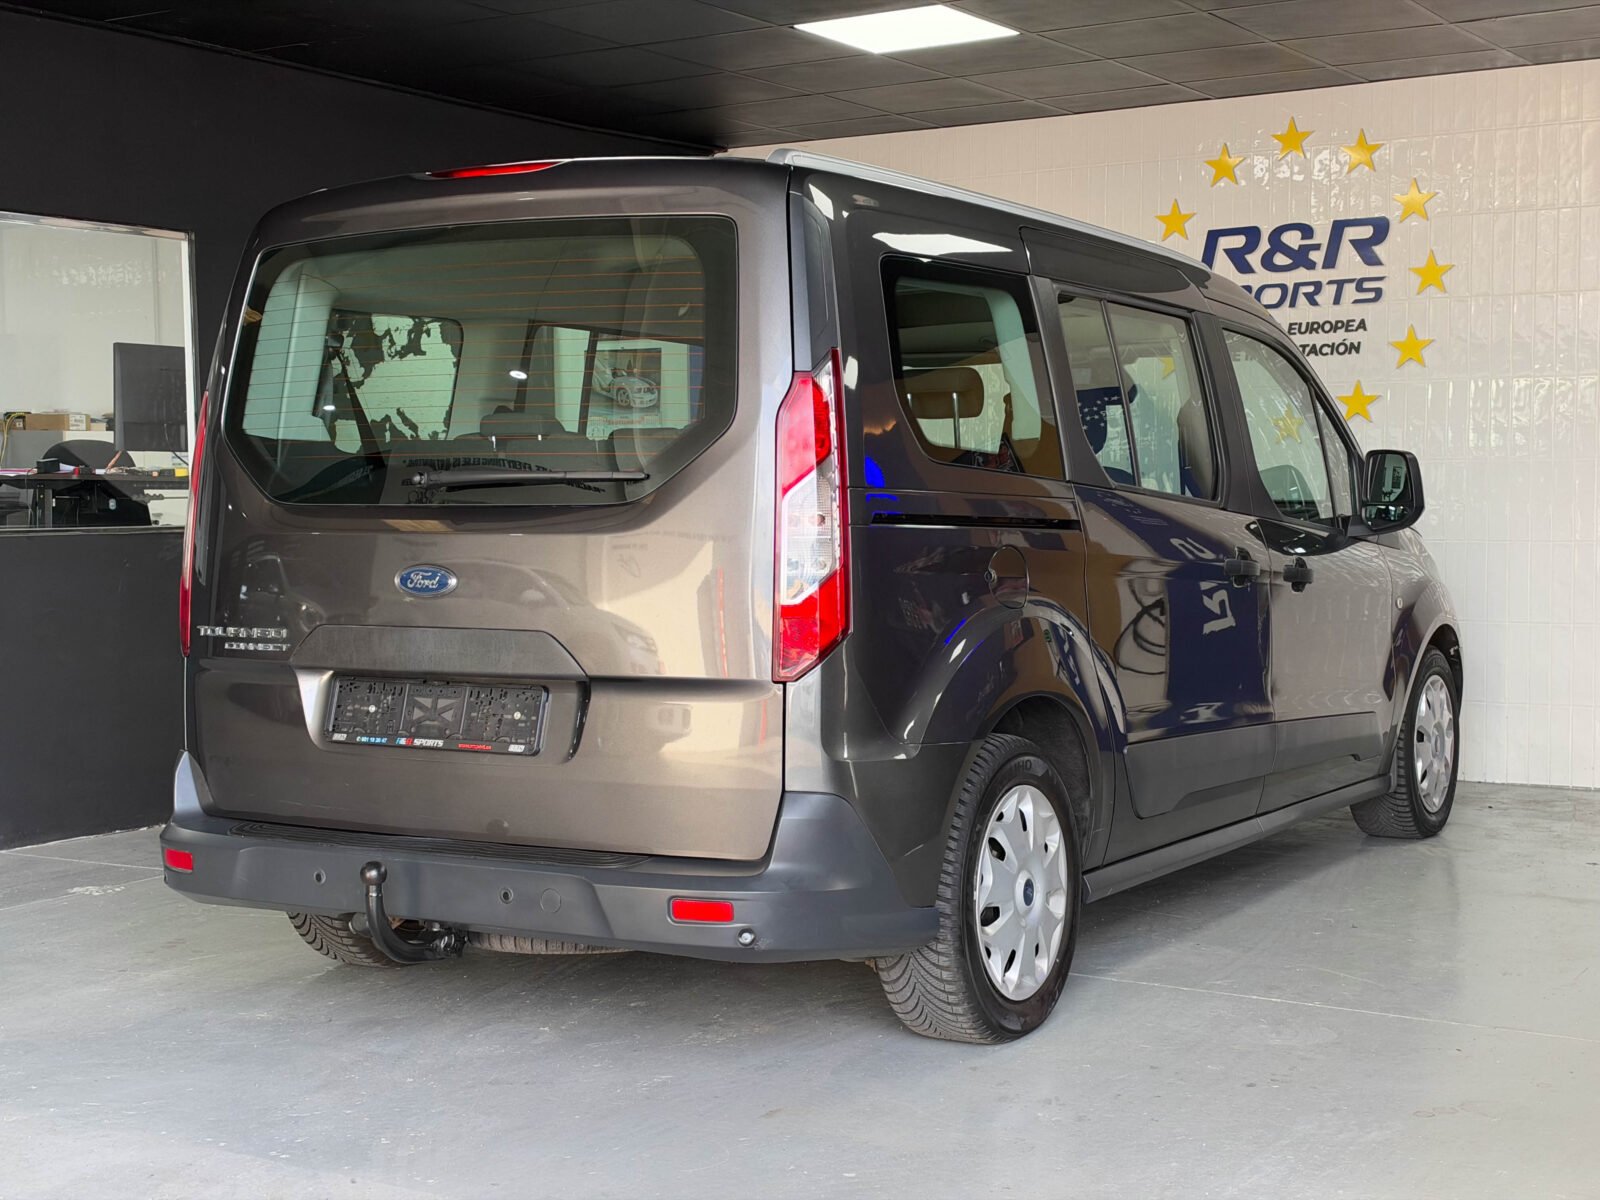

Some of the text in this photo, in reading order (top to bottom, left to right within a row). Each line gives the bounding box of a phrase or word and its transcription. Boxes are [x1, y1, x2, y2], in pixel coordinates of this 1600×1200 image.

[1201, 216, 1390, 274] R&R
[1240, 276, 1387, 309] ORTS
[1287, 318, 1368, 335] EUROPEA
[407, 571, 440, 589] Ford
[413, 738, 444, 748] SPORTS
